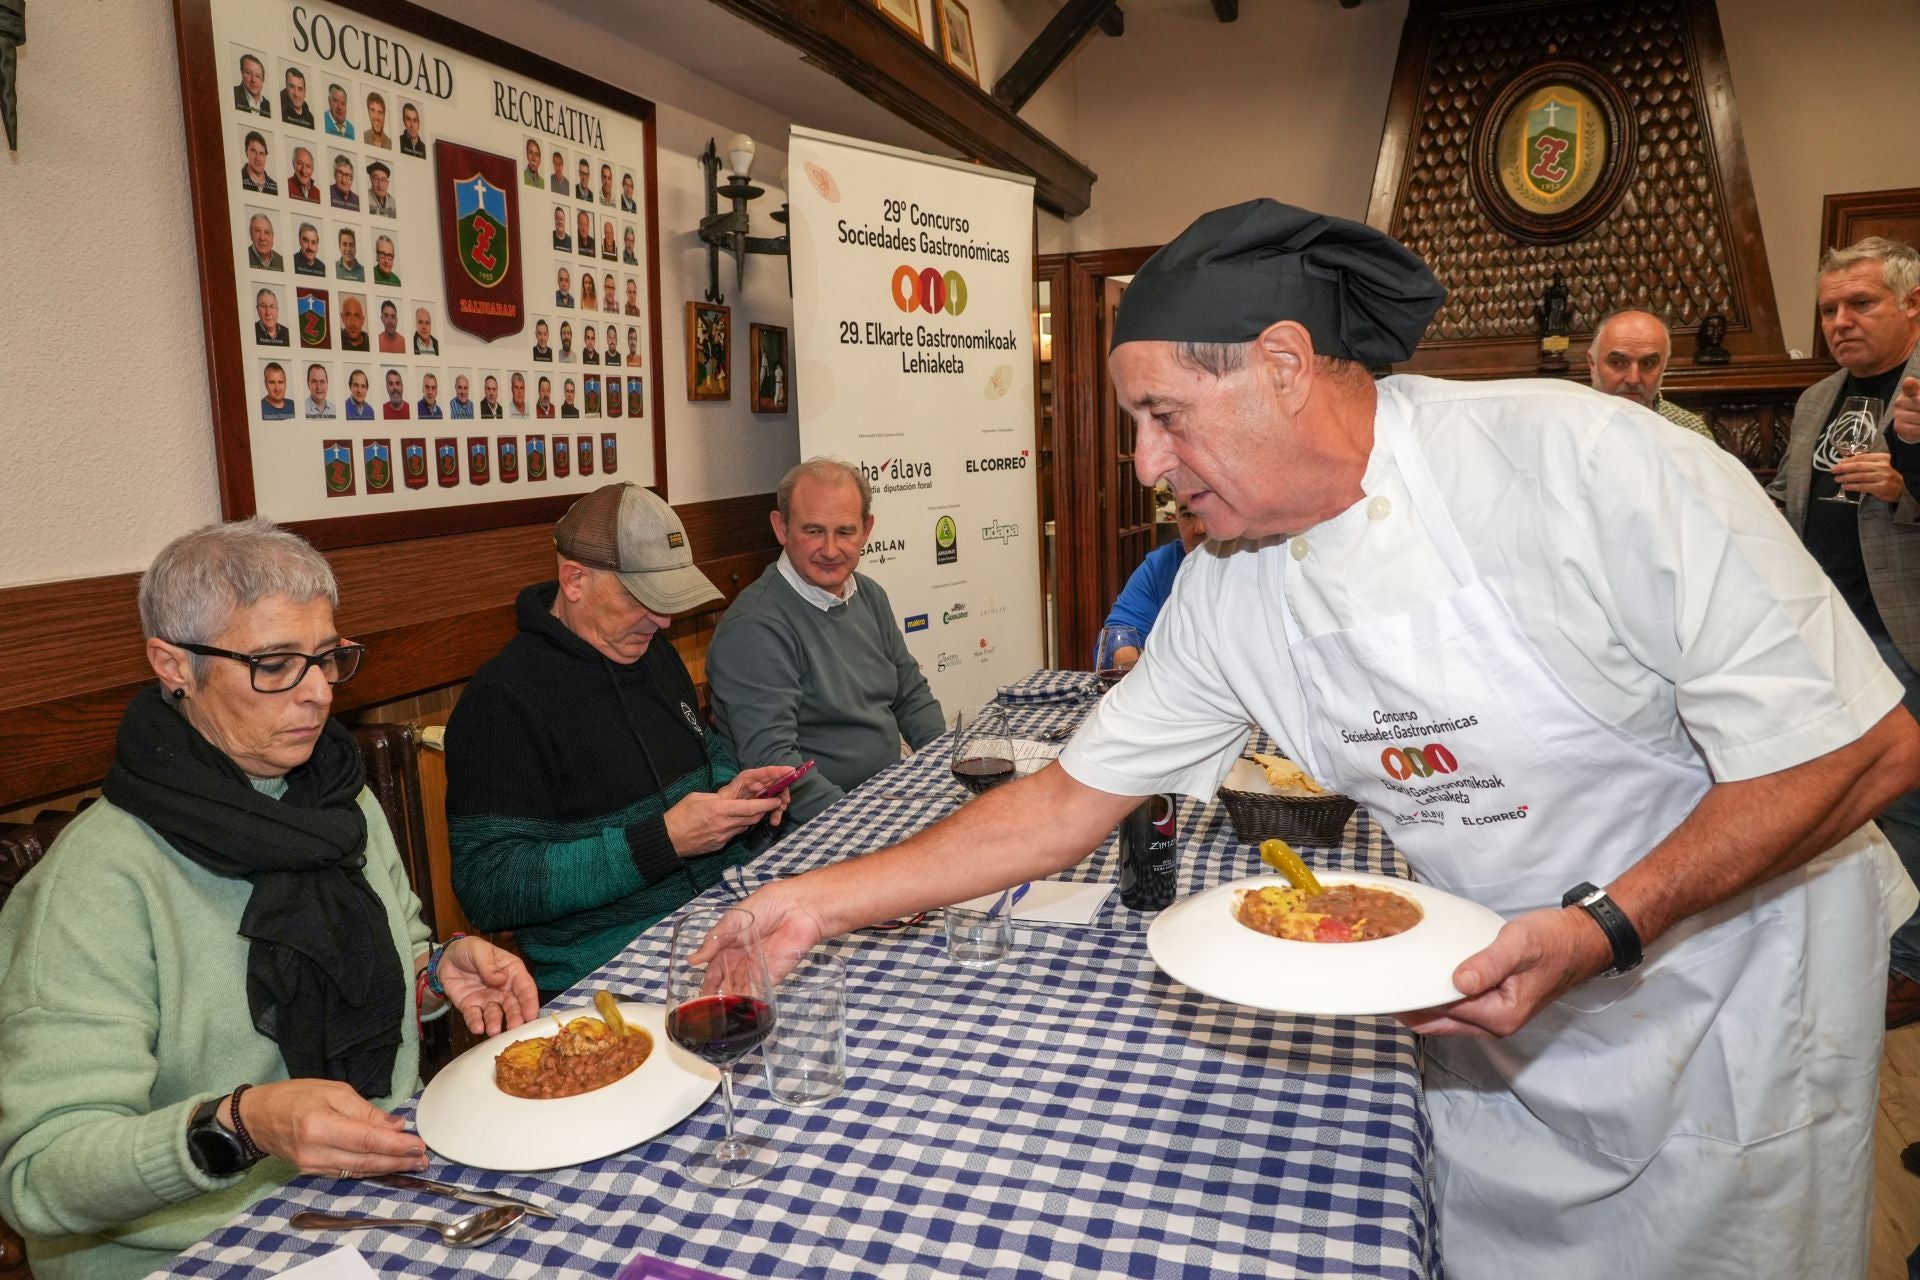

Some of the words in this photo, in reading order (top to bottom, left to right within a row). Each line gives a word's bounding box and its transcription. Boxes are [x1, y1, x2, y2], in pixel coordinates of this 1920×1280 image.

[292, 5, 454, 101] SOCIEDAD
[493, 79, 606, 152] RECREATIVA
[910, 203, 970, 234] Concurso
[837, 219, 917, 252] Sociedades
[919, 231, 1010, 264] Gastronómicas
[839, 320, 863, 344] 29.
[866, 321, 914, 347] Elkarte
[916, 325, 1017, 351] Gastronomikoak
[902, 350, 964, 375] Lehiaketa
[890, 458, 933, 480] álava
[966, 459, 979, 473] EL
[980, 456, 1027, 473] CORREO
[883, 481, 917, 494] diputación
[917, 480, 933, 490] foral
[982, 520, 1019, 545] udapa
[1373, 710, 1418, 725] Concurso
[1393, 714, 1479, 740] Gastronómicas
[1410, 774, 1506, 798] Gastronomikoak
[1415, 790, 1470, 806] Lehiaketa
[1461, 816, 1476, 827] EL
[1477, 809, 1527, 826] CORREO
